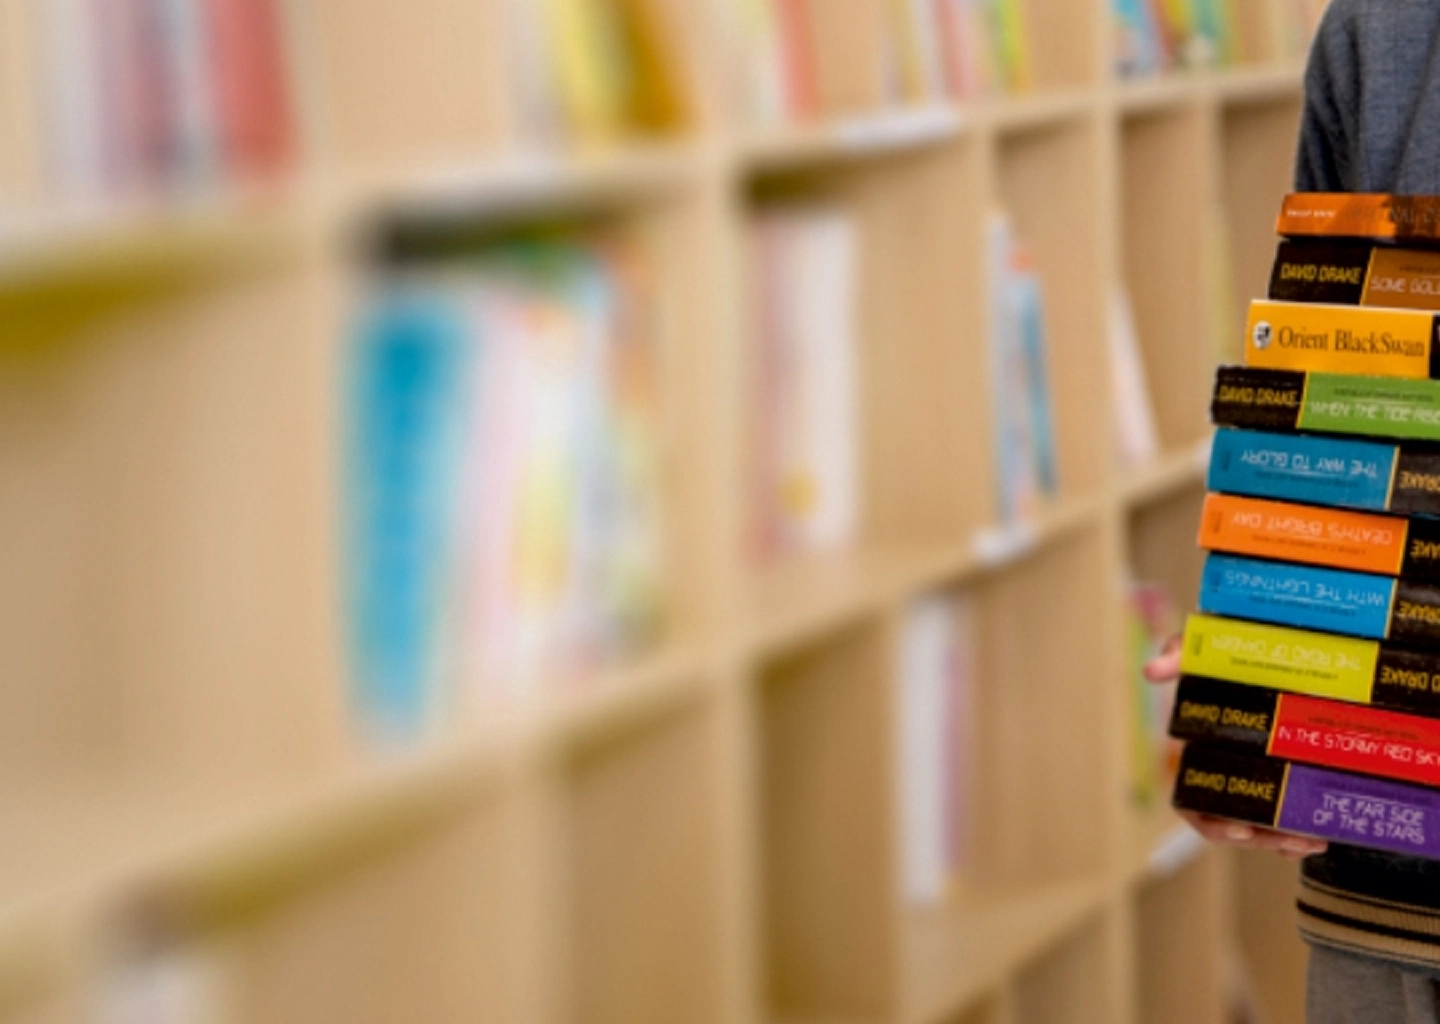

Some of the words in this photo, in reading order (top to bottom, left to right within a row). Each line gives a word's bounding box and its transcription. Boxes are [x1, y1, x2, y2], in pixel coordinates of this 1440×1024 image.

[1281, 263, 1317, 282] DAVID
[1319, 266, 1362, 285] DRAKE
[1370, 277, 1406, 294] SOME
[1278, 325, 1329, 351] Orient
[1334, 329, 1425, 358] BlackSwan
[1218, 385, 1254, 403] DAVID
[1256, 388, 1298, 406] DRAKE
[1310, 400, 1350, 417] WHEN
[1355, 403, 1378, 419] THE
[1240, 449, 1288, 468] GLORY
[1292, 453, 1310, 469] TO
[1315, 456, 1345, 473] WAY
[1350, 460, 1378, 477] THE
[1230, 511, 1262, 527] DAY
[1266, 516, 1323, 536] BRIGHT
[1314, 583, 1342, 600] THE
[1346, 590, 1385, 607] WITH
[1334, 653, 1362, 670] THE
[1380, 666, 1428, 688] DRAKE
[1180, 701, 1219, 722] DAVID
[1220, 708, 1269, 730] DRAKE
[1278, 726, 1292, 741] IN
[1295, 728, 1320, 747] THE
[1323, 733, 1380, 756] STORMY
[1383, 741, 1412, 762] RED
[1184, 769, 1225, 792] DAVID
[1227, 775, 1275, 800] DRAKE
[1320, 793, 1350, 813] THE
[1356, 798, 1386, 818] FAR
[1390, 803, 1425, 824] SIDE
[1313, 809, 1334, 826] OF
[1338, 813, 1367, 835] THE
[1373, 819, 1426, 845] STARS
